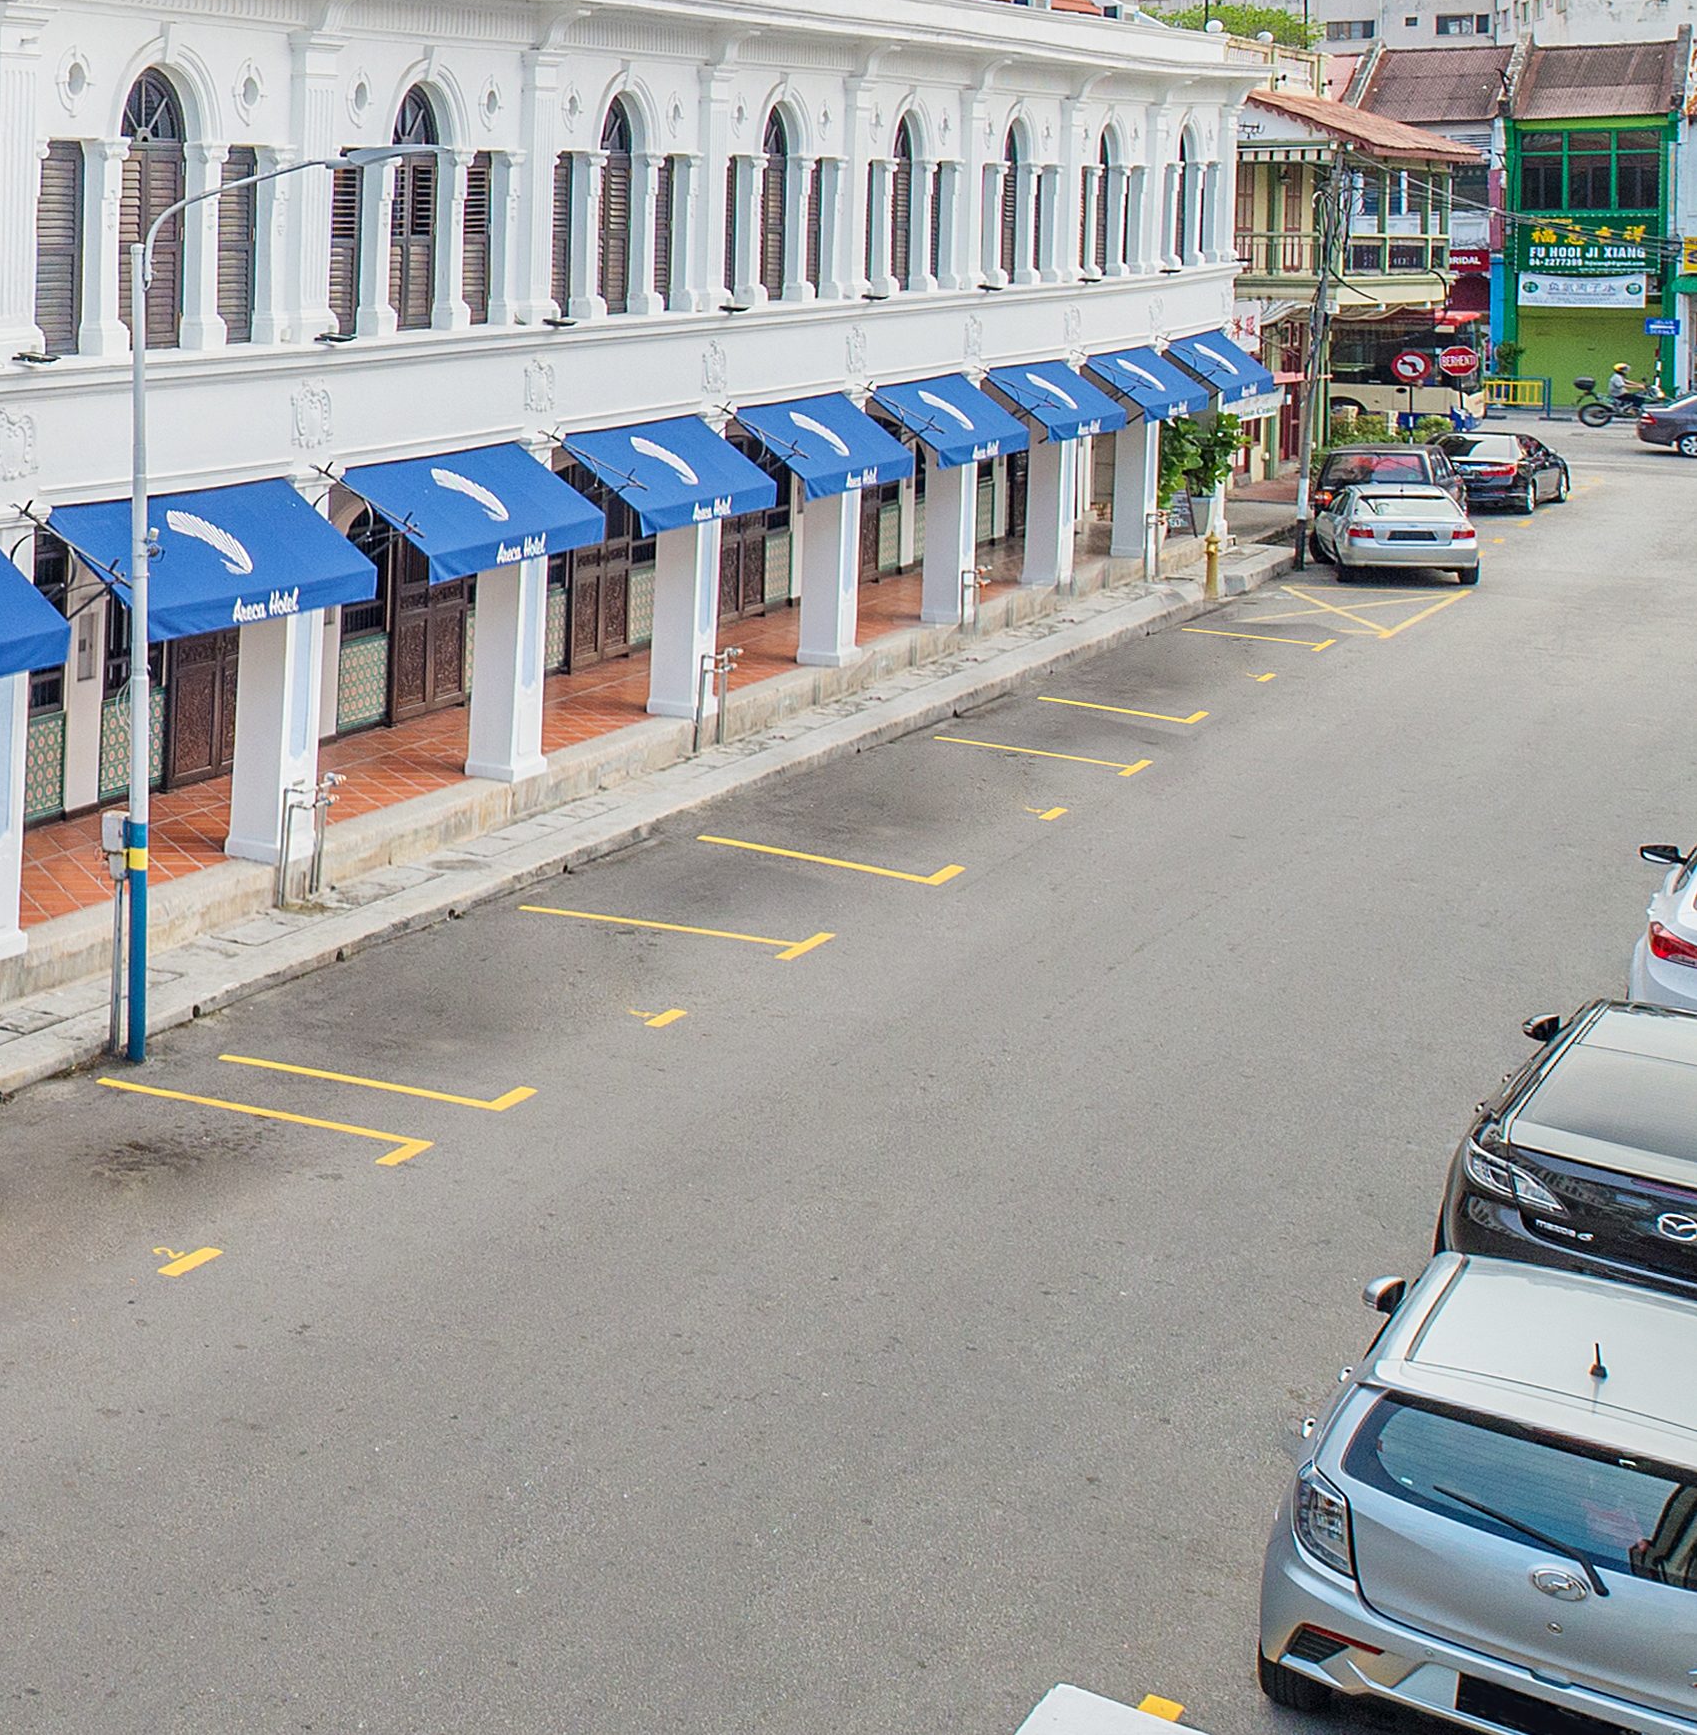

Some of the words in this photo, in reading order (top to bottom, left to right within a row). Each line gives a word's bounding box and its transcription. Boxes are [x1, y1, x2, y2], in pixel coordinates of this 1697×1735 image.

[1529, 246, 1546, 258] FU
[1549, 246, 1582, 258] HOOI
[1585, 246, 1599, 259] JI
[1603, 246, 1646, 259] XIANG
[1440, 355, 1477, 368] BERHENTI
[232, 596, 267, 623] Areca
[269, 586, 300, 616] Hotel
